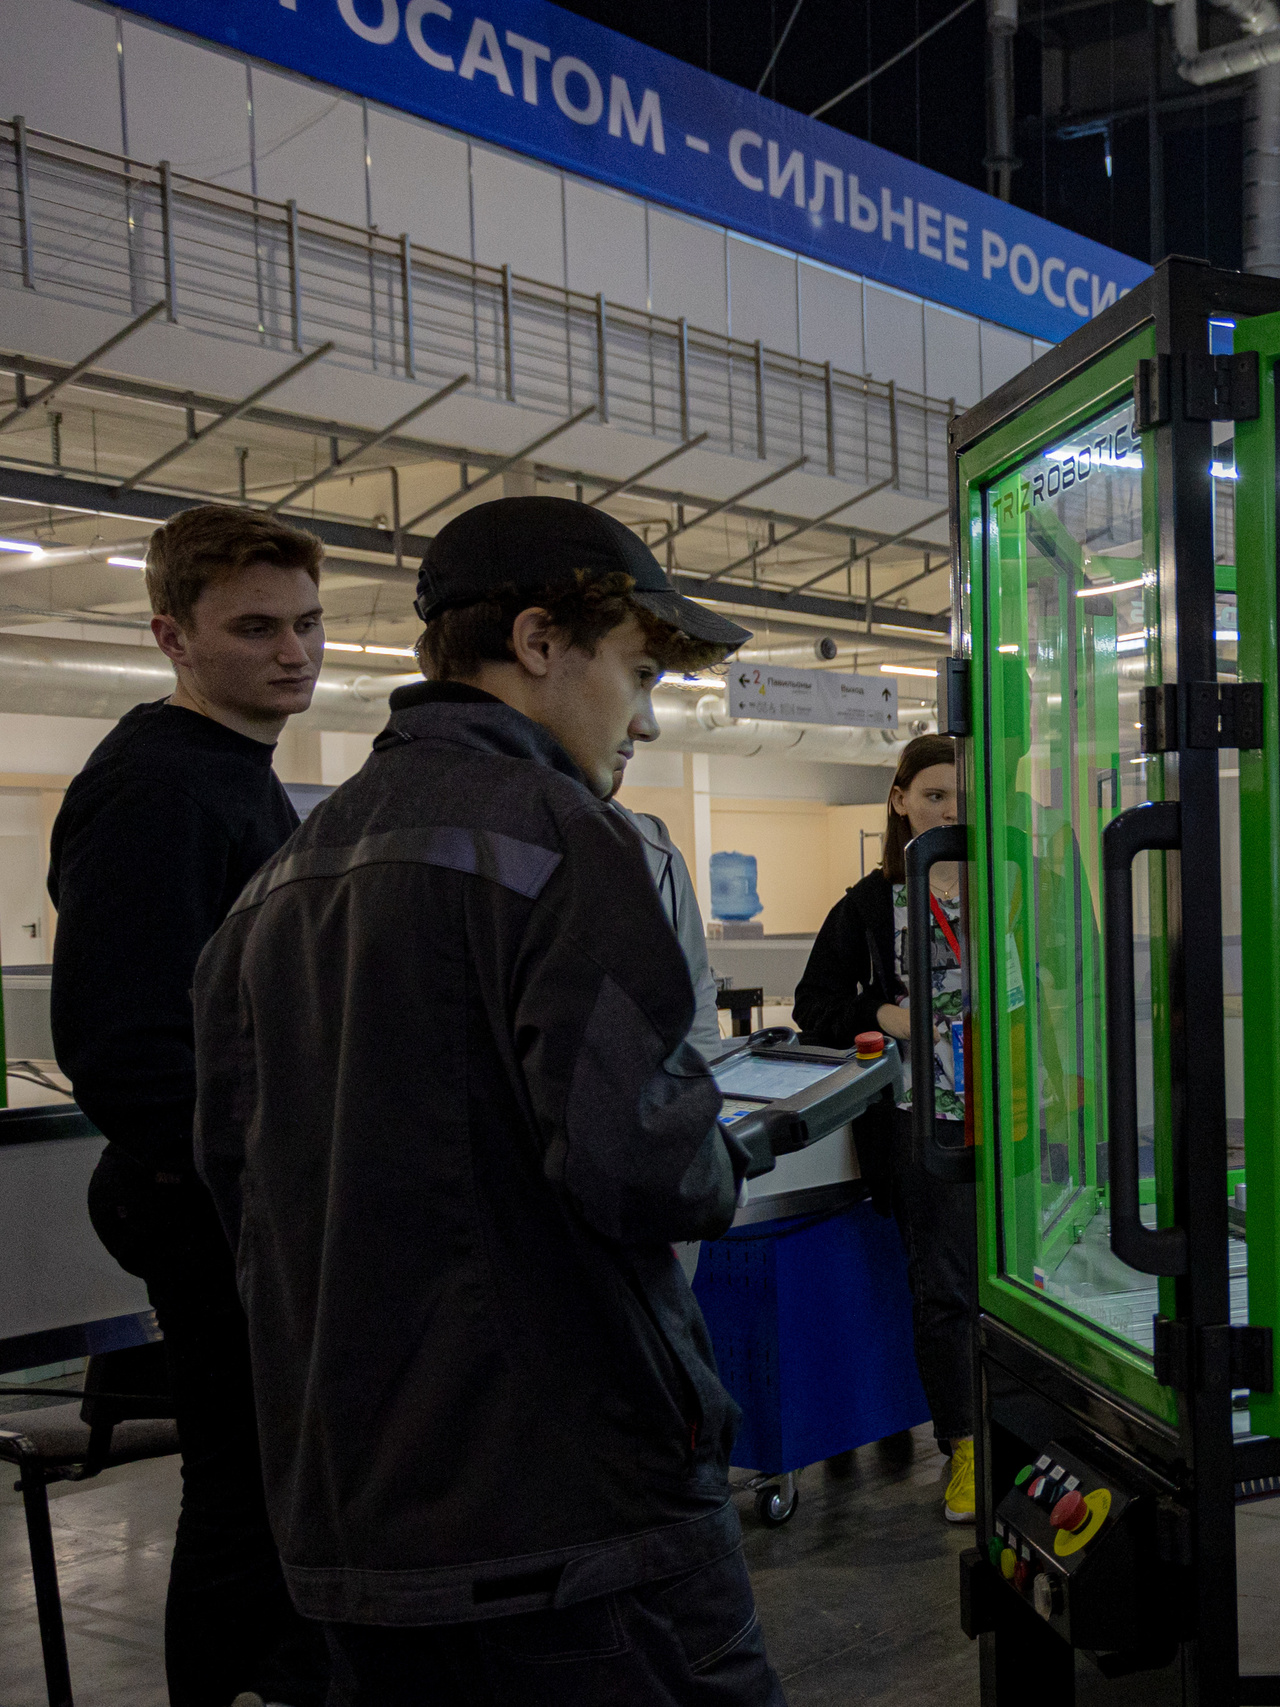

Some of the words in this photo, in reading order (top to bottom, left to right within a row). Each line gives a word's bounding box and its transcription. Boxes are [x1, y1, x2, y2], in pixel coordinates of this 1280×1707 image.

[280, 0, 667, 155] ОСАТОМ
[729, 129, 968, 272] СИЛЬНЕЕ
[982, 229, 1131, 319] РОССИ
[752, 670, 761, 685] 2
[758, 684, 766, 696] 4
